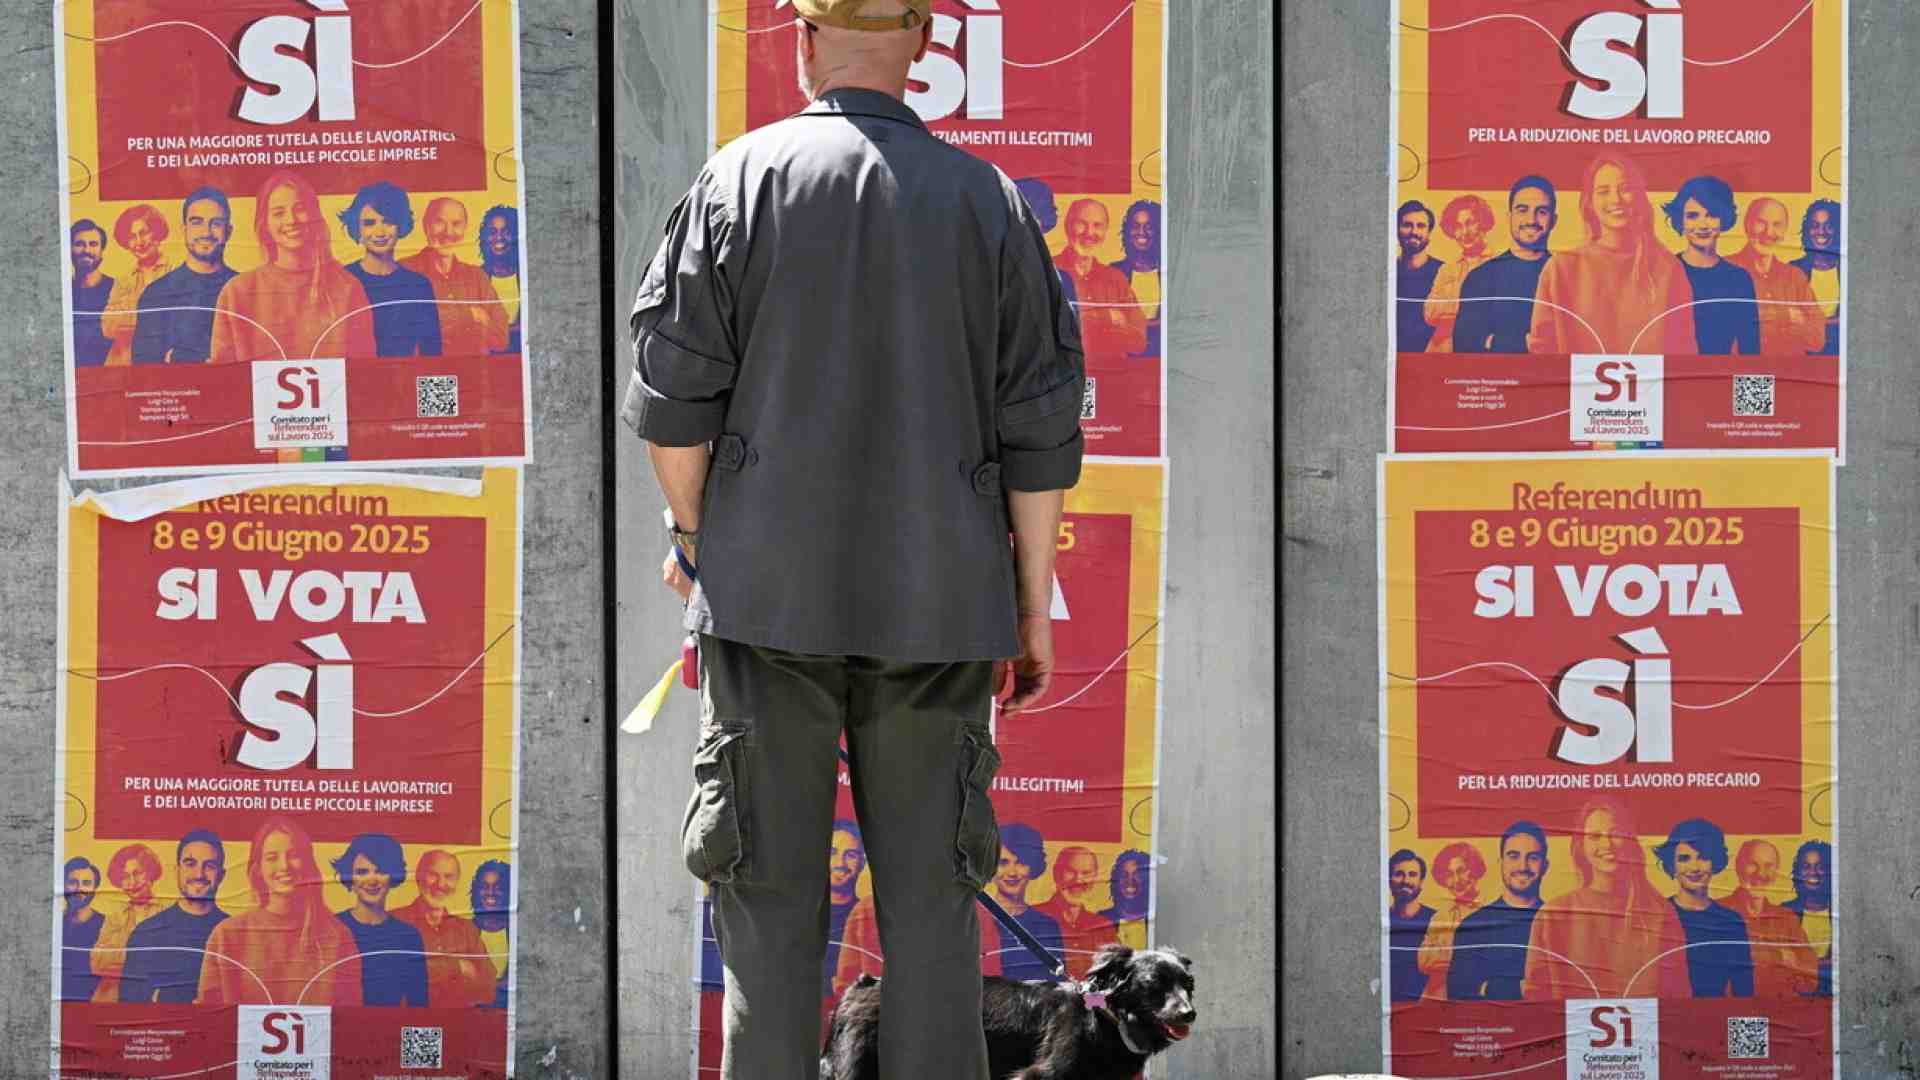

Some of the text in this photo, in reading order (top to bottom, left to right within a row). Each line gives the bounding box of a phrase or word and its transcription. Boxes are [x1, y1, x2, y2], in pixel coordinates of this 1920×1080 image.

[237, 0, 356, 124] SÌ
[1567, 0, 1684, 120] SÌ
[128, 129, 456, 150] PER UNA MAGGIORE TUTELA DELLE LAVORATRICI
[932, 130, 1092, 146] ZIAMENTI ILLEGITTIMI
[1469, 128, 1771, 144] PER LA RIDUZIONE DEL LAVORO PRECARIO
[147, 147, 437, 168] E DEI LAVORATORI DELLE PICCOLE IMPRESE
[277, 367, 320, 410] Sì
[1594, 361, 1637, 402] Sì
[1587, 408, 1626, 417] Comitato
[1513, 481, 1701, 511] Referendum
[153, 520, 430, 561] 8 e 9 Giugno 2025
[1470, 516, 1744, 555] 8 e 9 Giugno 2025
[156, 567, 426, 623] SI VOTA
[1473, 563, 1743, 618] SI VOTA
[236, 632, 353, 771] SÌ
[1556, 626, 1672, 765] SÌ
[124, 776, 453, 795] PER UNA MAGGIORE TUTELA DELLE LAVORATRICI
[1000, 777, 1084, 792] ILLEGITTIMI
[1459, 772, 1760, 789] PER LA RIDUZIONE DEL LAVORO PRECARIO
[144, 795, 433, 813] E DEI LAVORATORI DELLE PICCOLE IMPRESE
[261, 1012, 304, 1055] Sì
[1590, 1006, 1632, 1048] Sì
